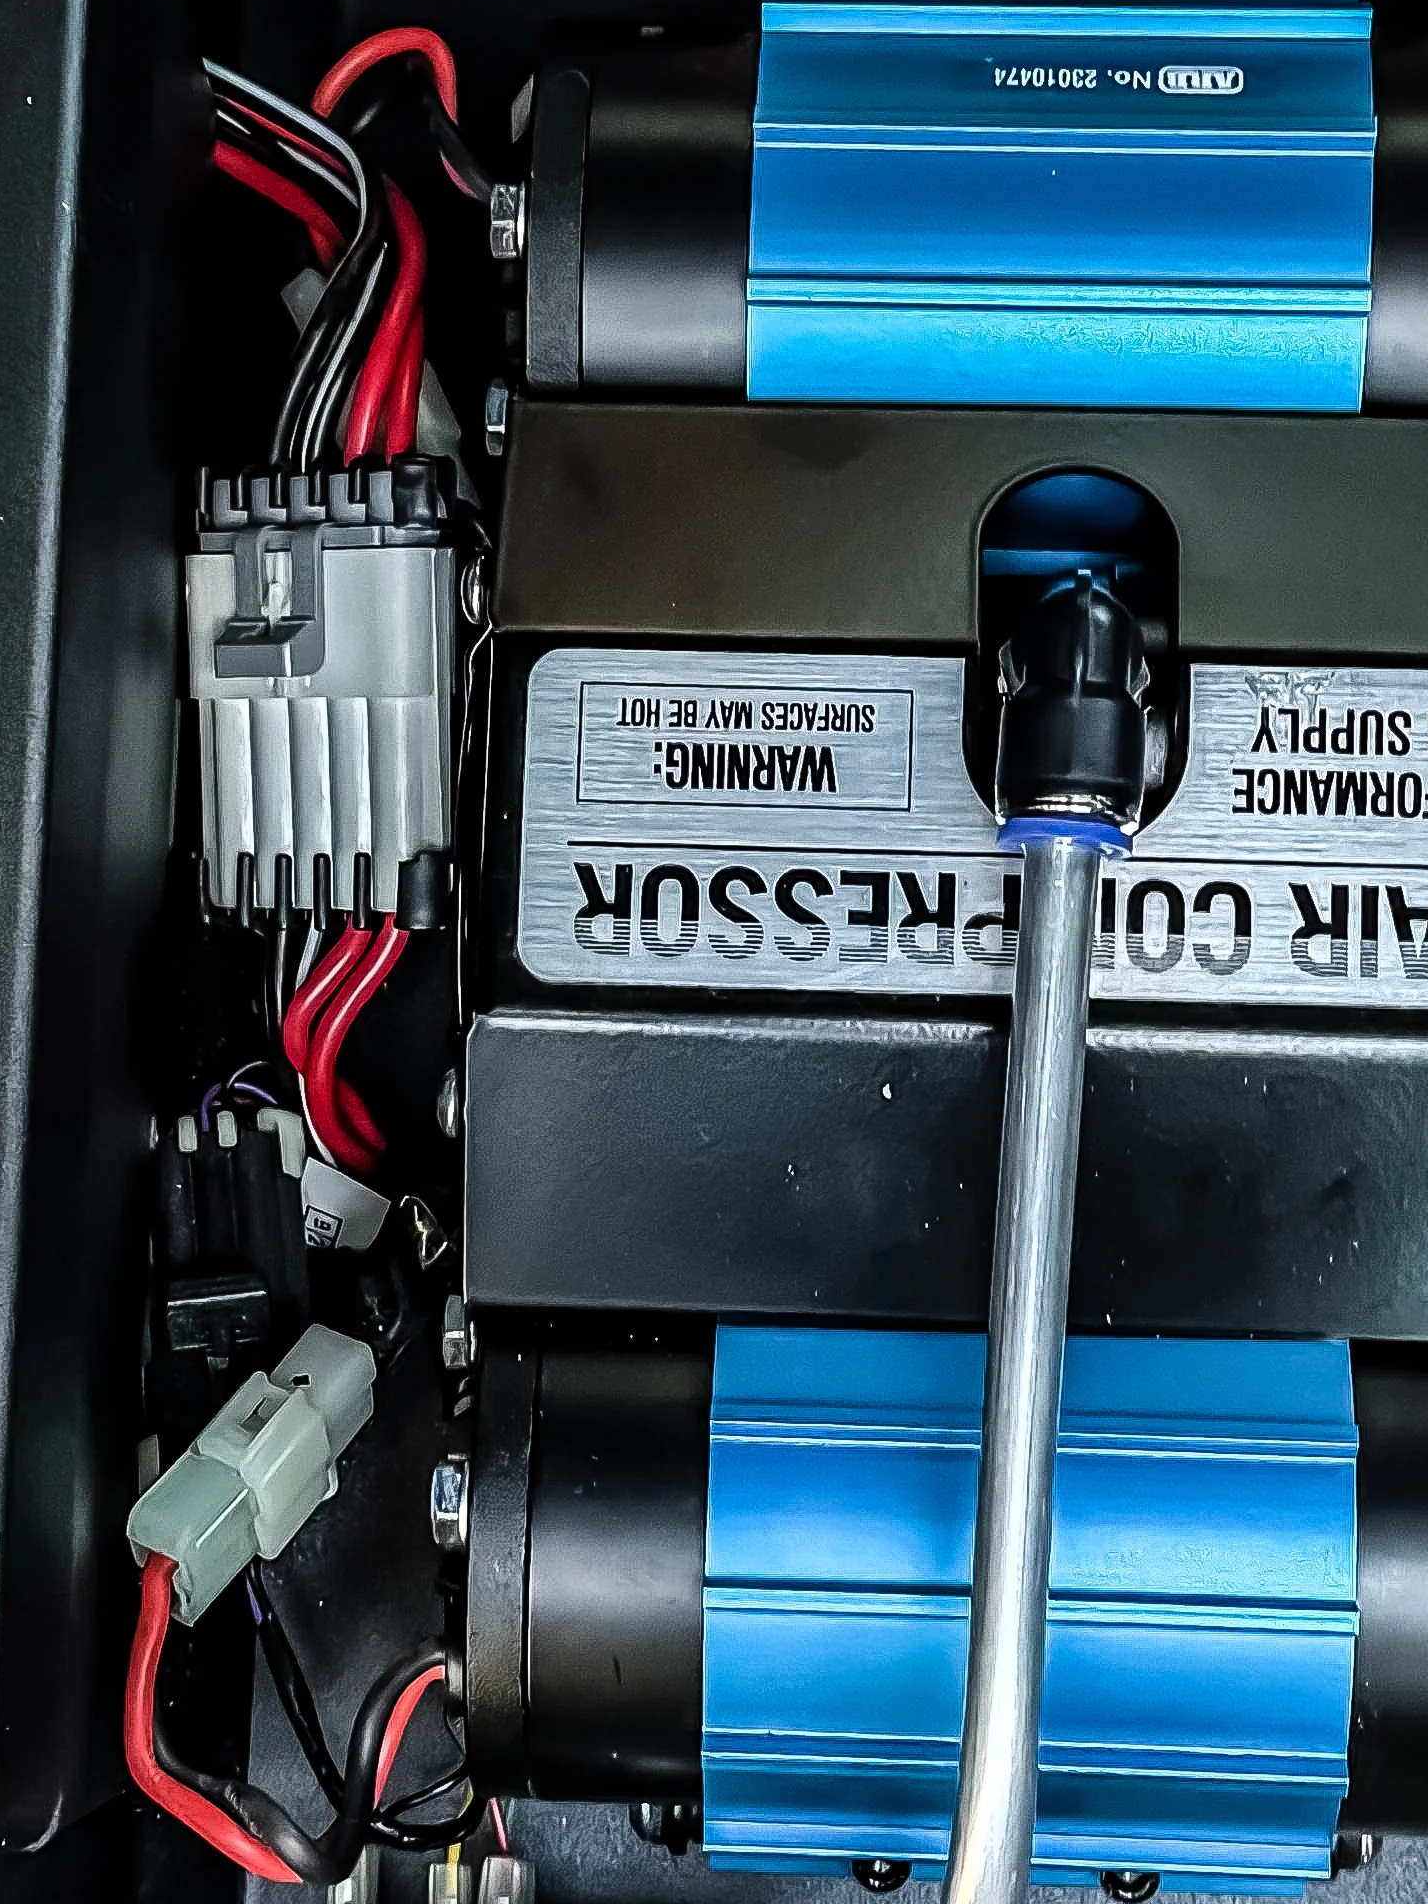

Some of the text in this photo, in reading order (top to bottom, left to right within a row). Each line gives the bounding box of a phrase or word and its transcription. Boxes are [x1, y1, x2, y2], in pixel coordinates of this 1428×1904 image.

[1108, 70, 1151, 90] No.
[617, 697, 875, 733] SURFACES MAY BE HOT
[1250, 706, 1412, 756] SUPPLY
[653, 740, 837, 793] WARNING:
